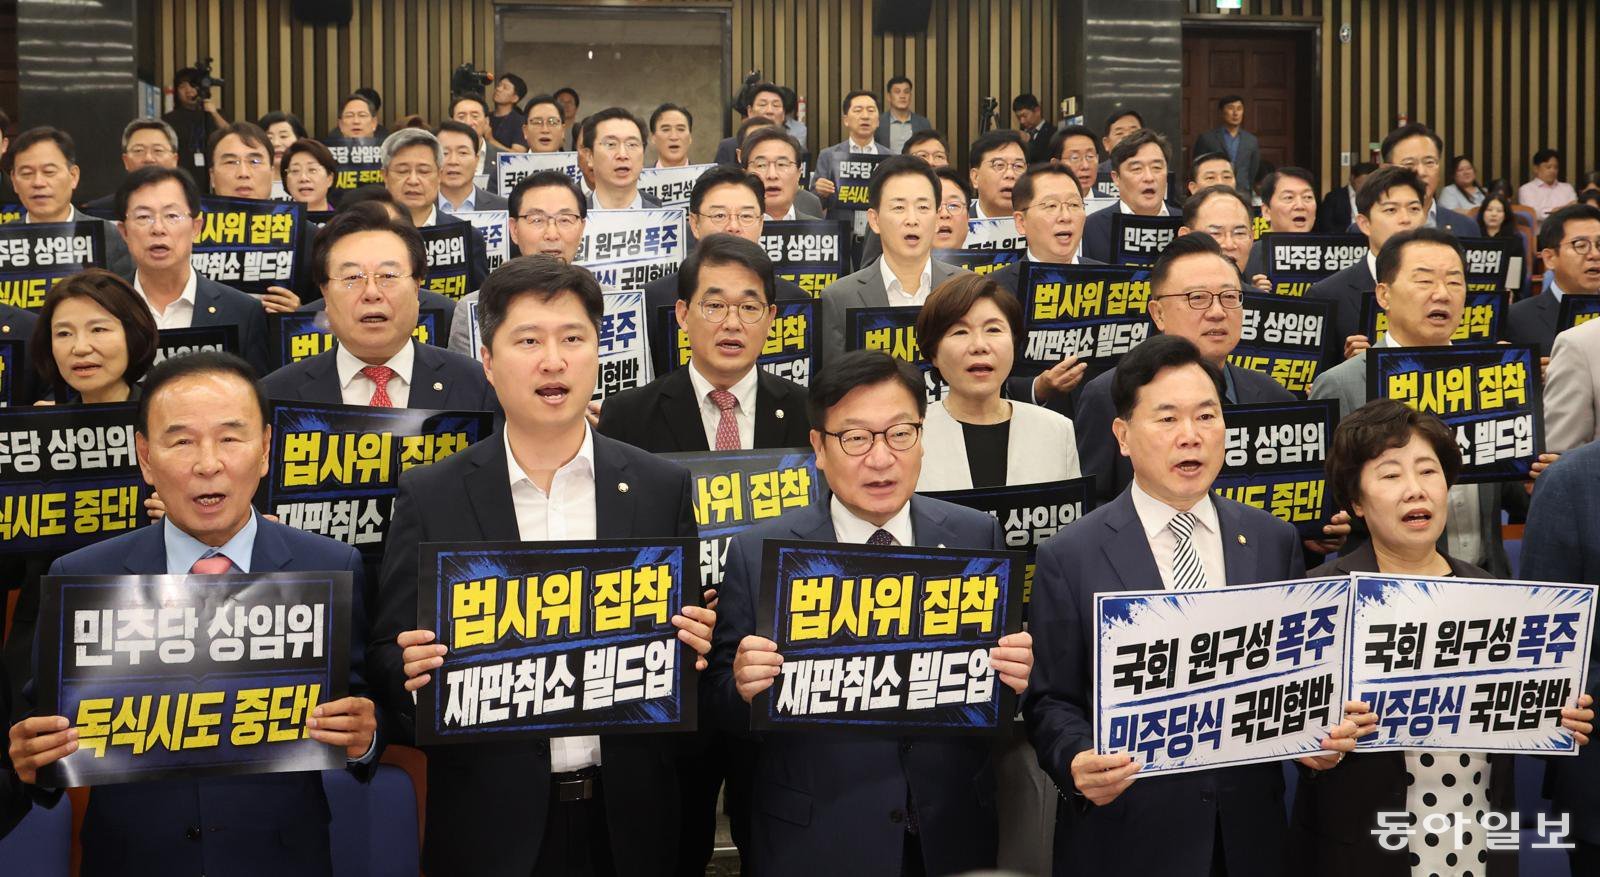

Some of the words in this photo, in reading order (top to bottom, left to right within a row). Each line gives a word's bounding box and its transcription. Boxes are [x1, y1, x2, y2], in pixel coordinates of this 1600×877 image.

[661, 180, 693, 202] 원구성
[840, 161, 872, 179] 민주당
[838, 185, 870, 204] 독식시
[34, 235, 93, 266] 상임위
[192, 211, 247, 243] 사위
[250, 213, 293, 244] 집착
[595, 229, 641, 260] 원구성
[644, 224, 678, 255] 폭주
[787, 234, 839, 262] 상임위
[1124, 227, 1175, 253] 민주당
[243, 250, 294, 281] 빌드업
[1275, 246, 1321, 271] 민주당
[1034, 281, 1105, 320] 법사위
[1107, 280, 1151, 316] 집착
[1024, 327, 1095, 361] 재판취소
[1096, 322, 1150, 358] 빌드업
[1264, 312, 1324, 347] 상임위
[1389, 365, 1473, 416] 법사위
[1478, 362, 1527, 410] 집착
[47, 424, 137, 471] 상임위
[284, 432, 393, 487] 법사위
[1254, 422, 1326, 465] 상임위
[1475, 414, 1534, 467] 빌드업
[73, 486, 139, 534] 중단!
[750, 467, 811, 520] 집착
[1270, 480, 1326, 522] 중단!
[452, 570, 583, 650] 법사위
[593, 563, 673, 632] 집착
[789, 574, 914, 642] 법사위
[922, 574, 998, 634] 집착
[73, 607, 199, 667] 민주당
[207, 603, 325, 663] 상임위
[1113, 638, 1179, 695] 국회
[1188, 619, 1274, 685] 원구성
[1276, 605, 1339, 666] 폭주
[1364, 622, 1428, 673] 국회
[1433, 617, 1517, 669] 원구성
[1517, 612, 1581, 665] 폭주
[443, 655, 576, 727] 재판취소
[582, 638, 676, 711] 빌드업
[776, 653, 902, 716] 재판취소
[906, 648, 996, 711] 빌드업
[1469, 677, 1572, 733] 국민협박
[75, 691, 225, 759] 독식시도
[230, 684, 322, 747] 중단!
[1109, 698, 1226, 763] 민주당식
[1231, 673, 1334, 744] 국민협박
